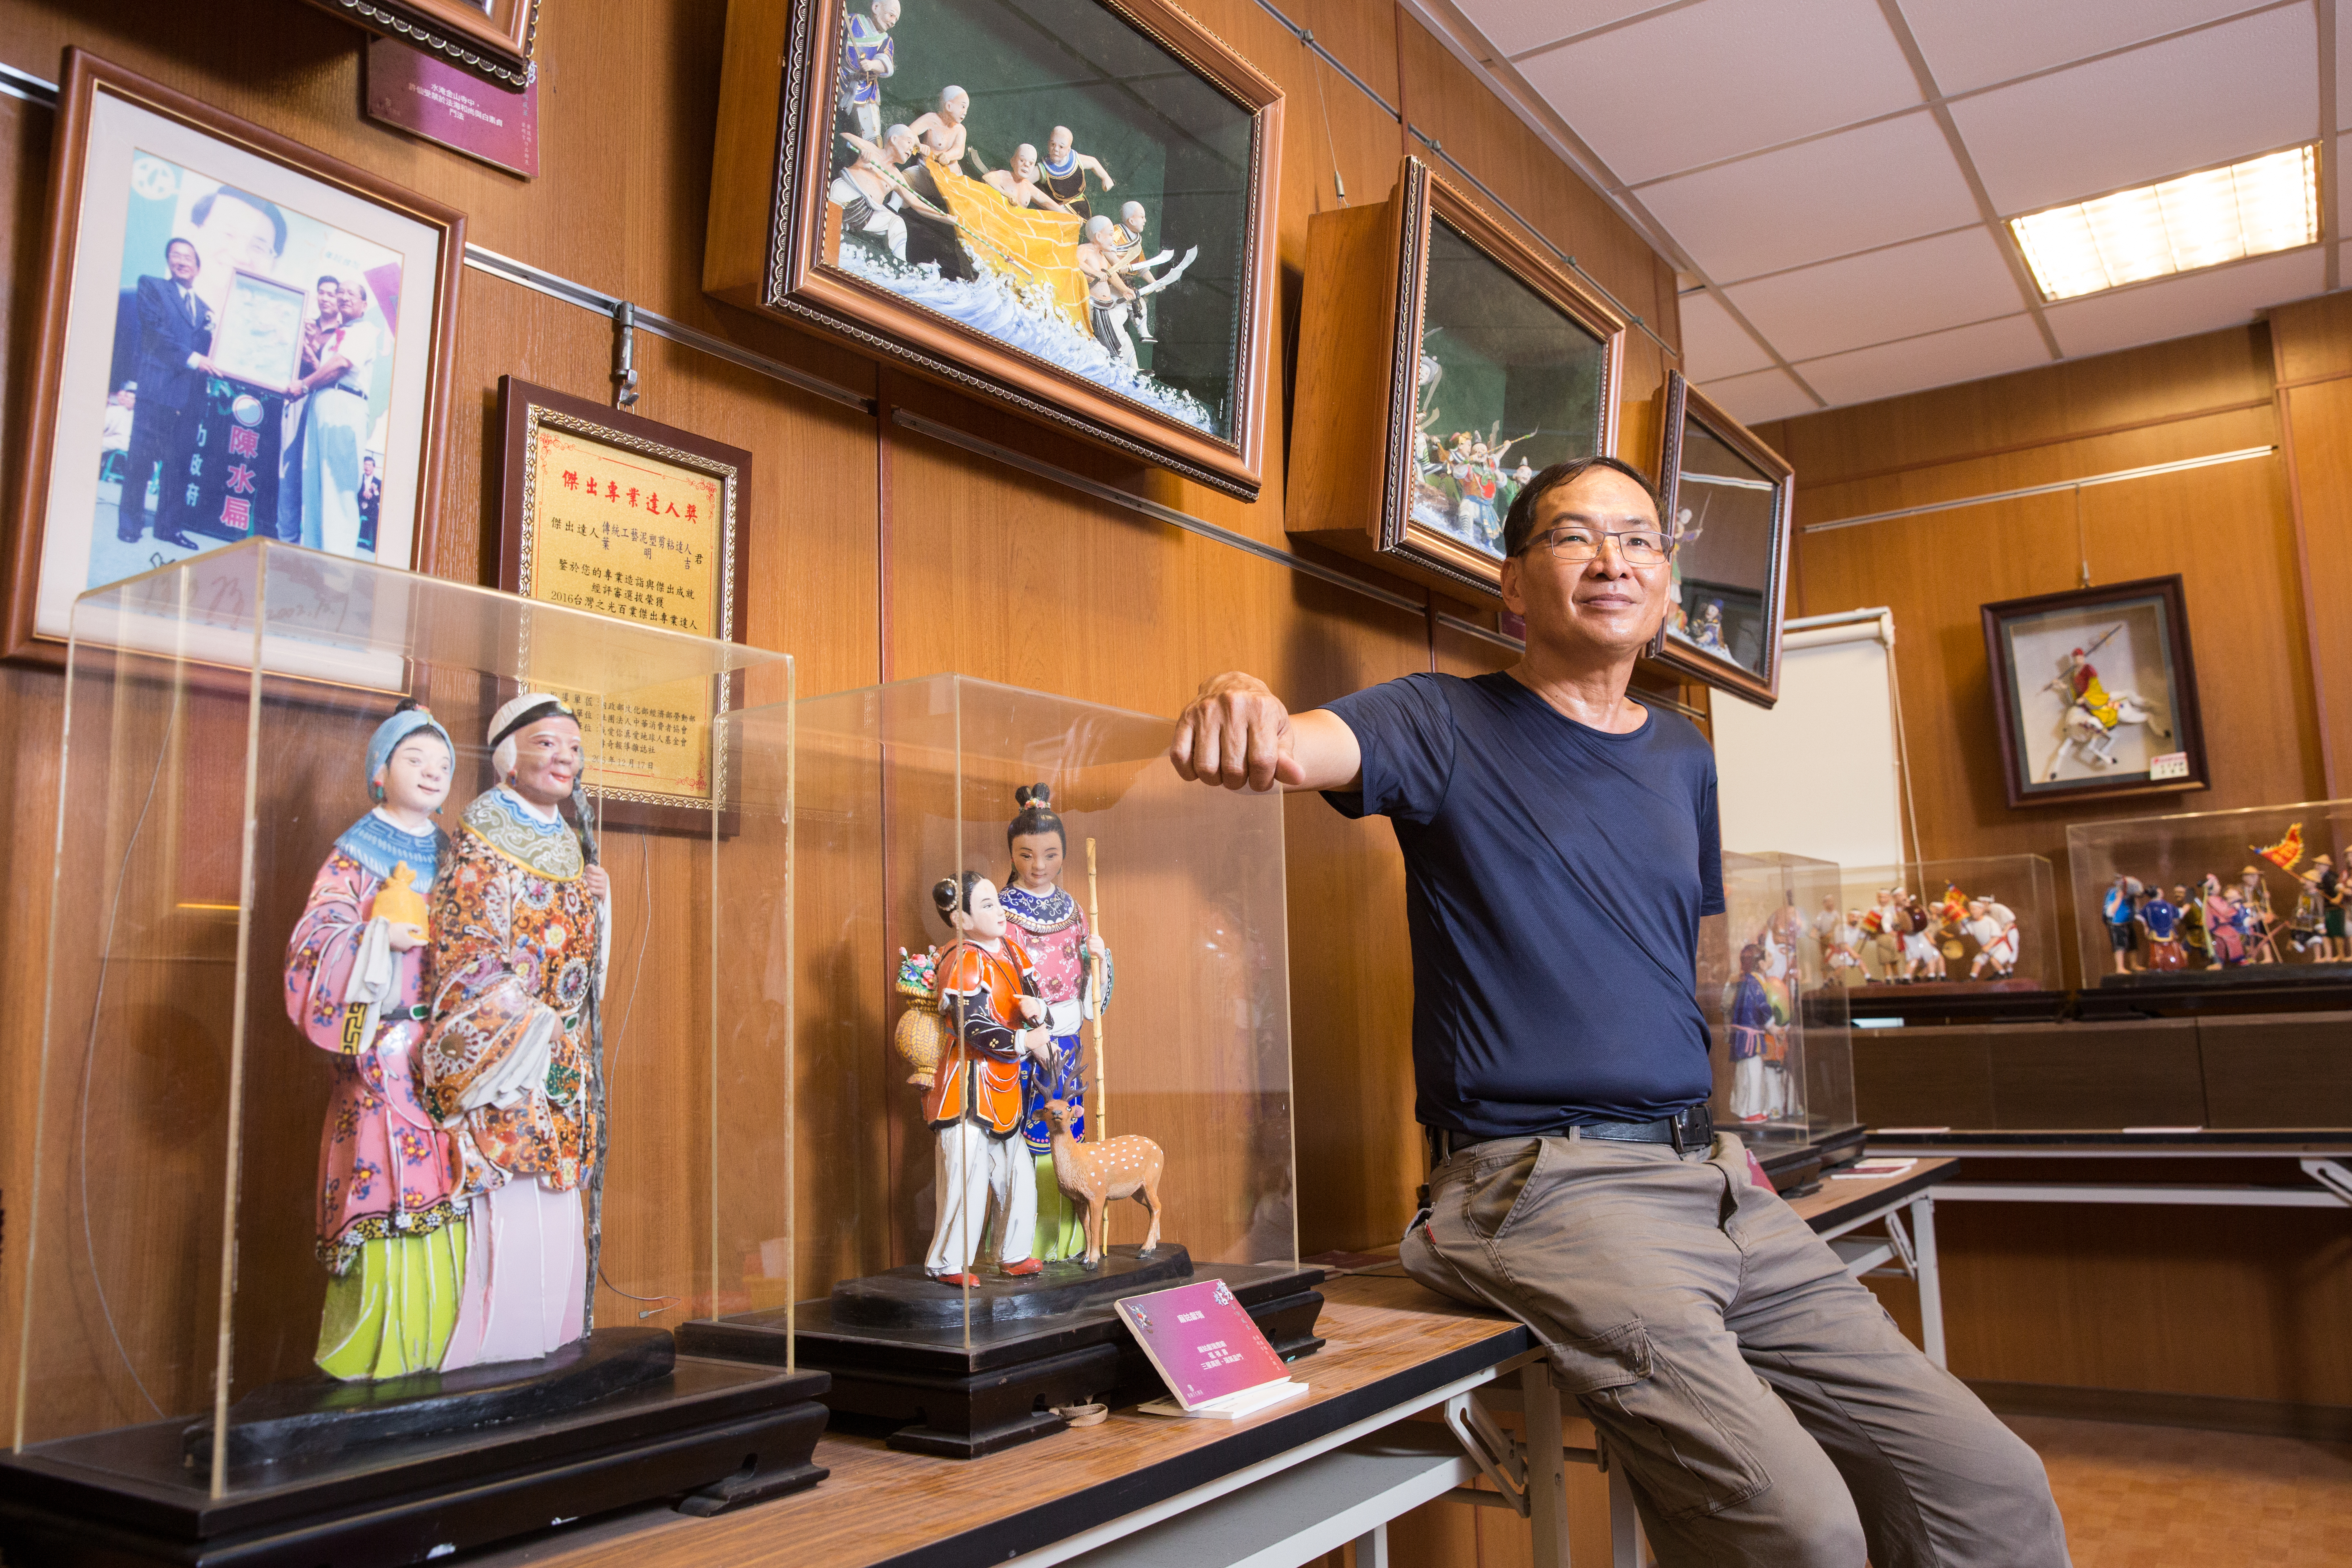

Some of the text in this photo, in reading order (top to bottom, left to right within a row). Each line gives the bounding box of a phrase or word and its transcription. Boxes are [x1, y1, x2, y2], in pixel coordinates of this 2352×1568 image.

[220, 425, 260, 530] 陳水扁
[562, 470, 698, 524] 傑出專業達人獎
[551, 517, 703, 564] 傑出達人 傳統工藝泥塑剪粘達人 君
[551, 591, 698, 630] 2016台灣之光百業傑出專業達人
[592, 583, 664, 608] 經評審選拔榮獲
[1177, 1310, 1205, 1323] 麻姑獻瑞
